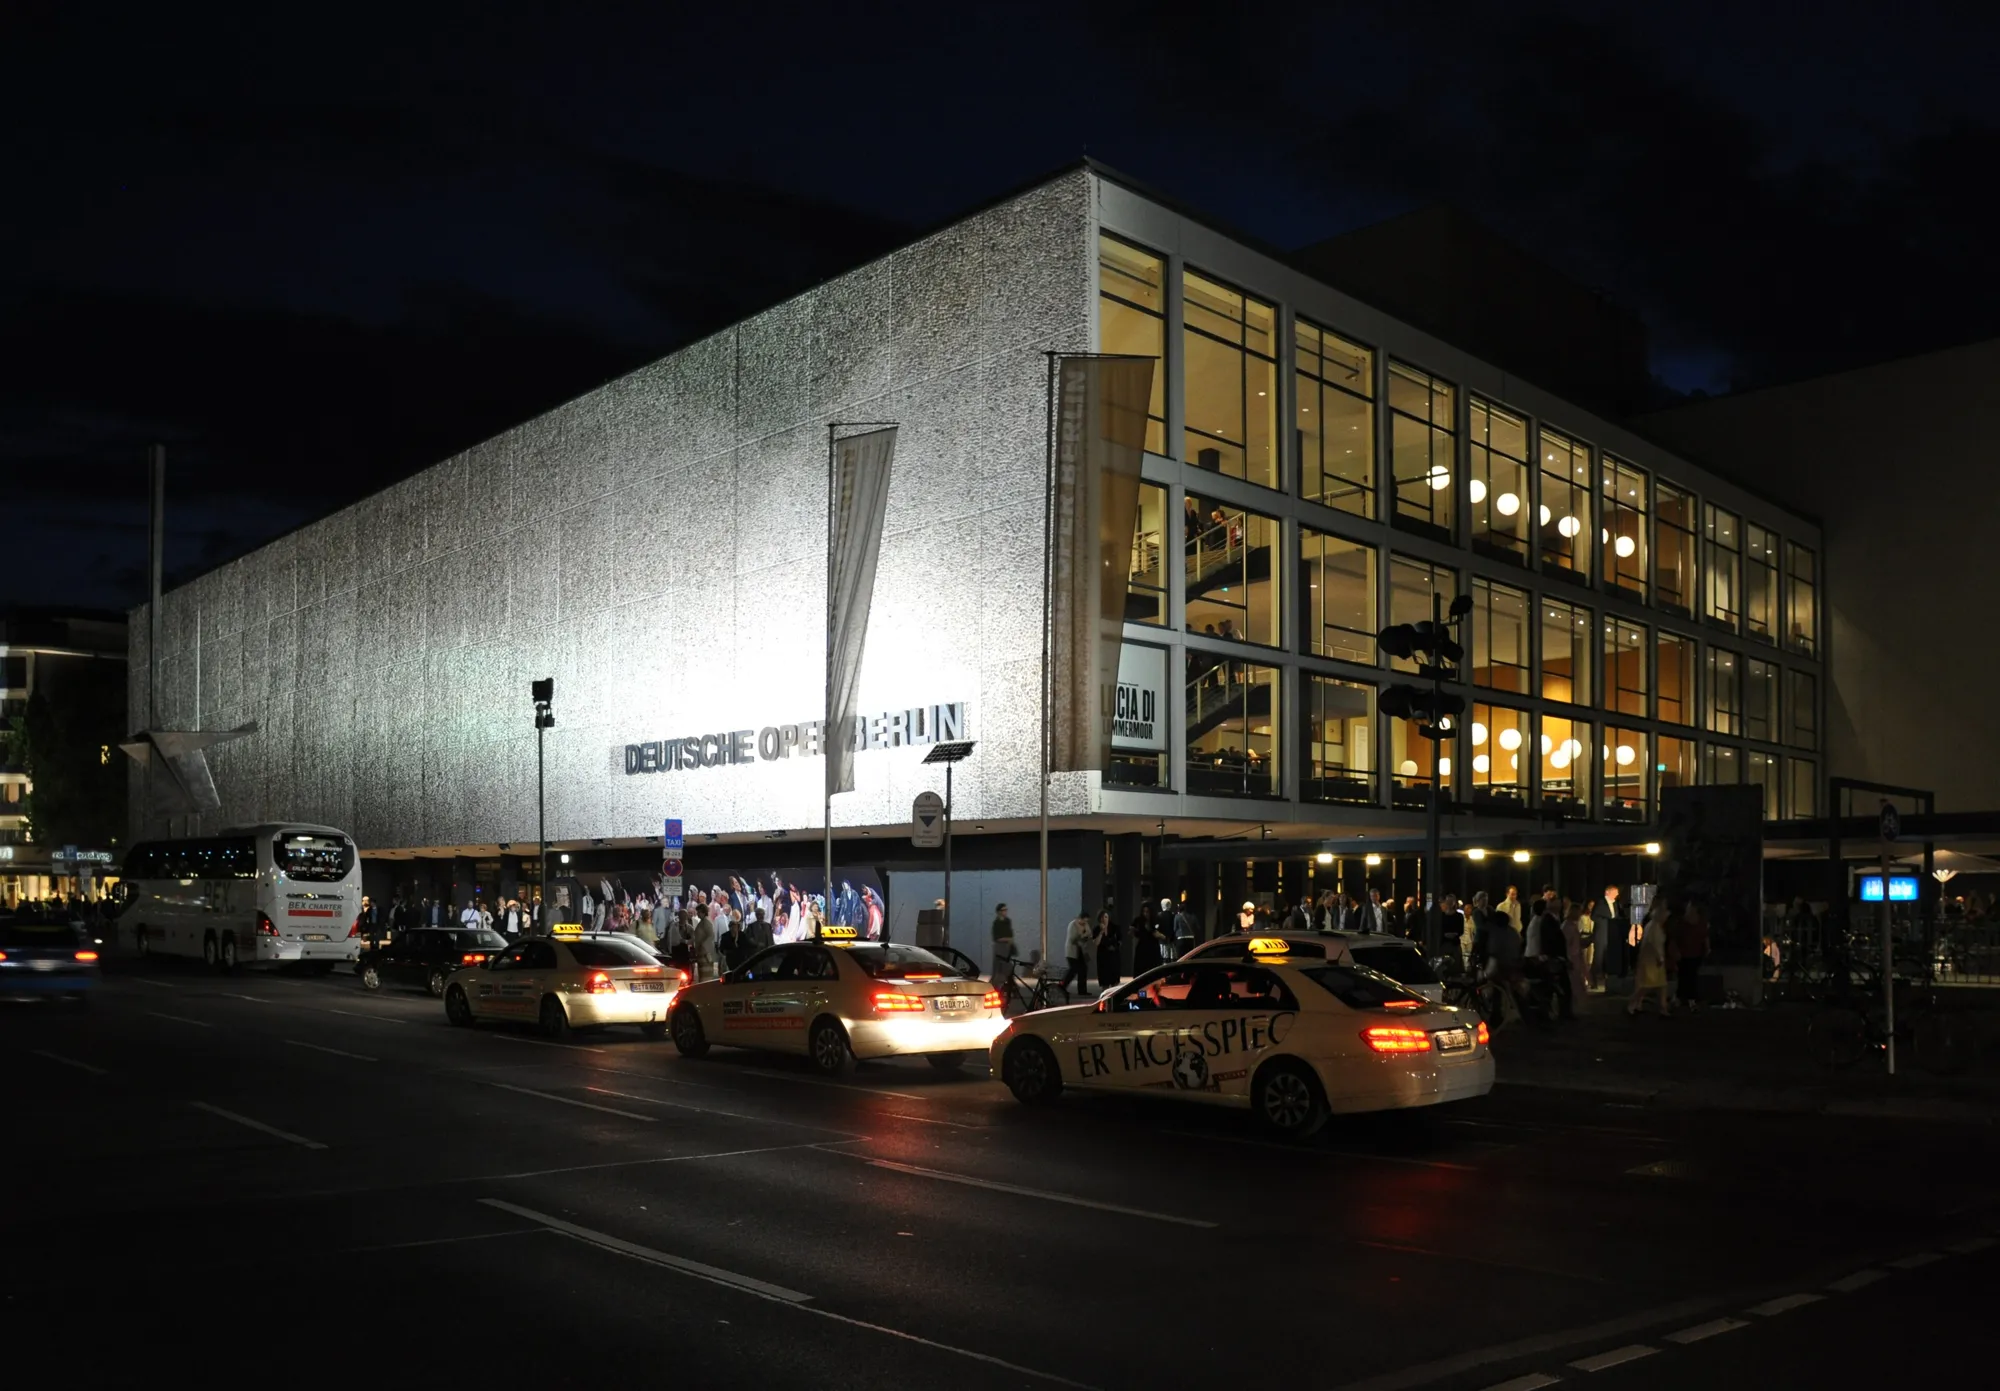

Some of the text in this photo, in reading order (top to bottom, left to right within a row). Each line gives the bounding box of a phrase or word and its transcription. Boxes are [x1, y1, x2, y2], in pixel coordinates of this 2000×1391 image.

[1142, 689, 1155, 722] DI
[625, 729, 755, 776] DEUTSCHE
[845, 701, 965, 753] BERLIN
[666, 839, 681, 847] TAXI
[288, 901, 307, 909] BEX
